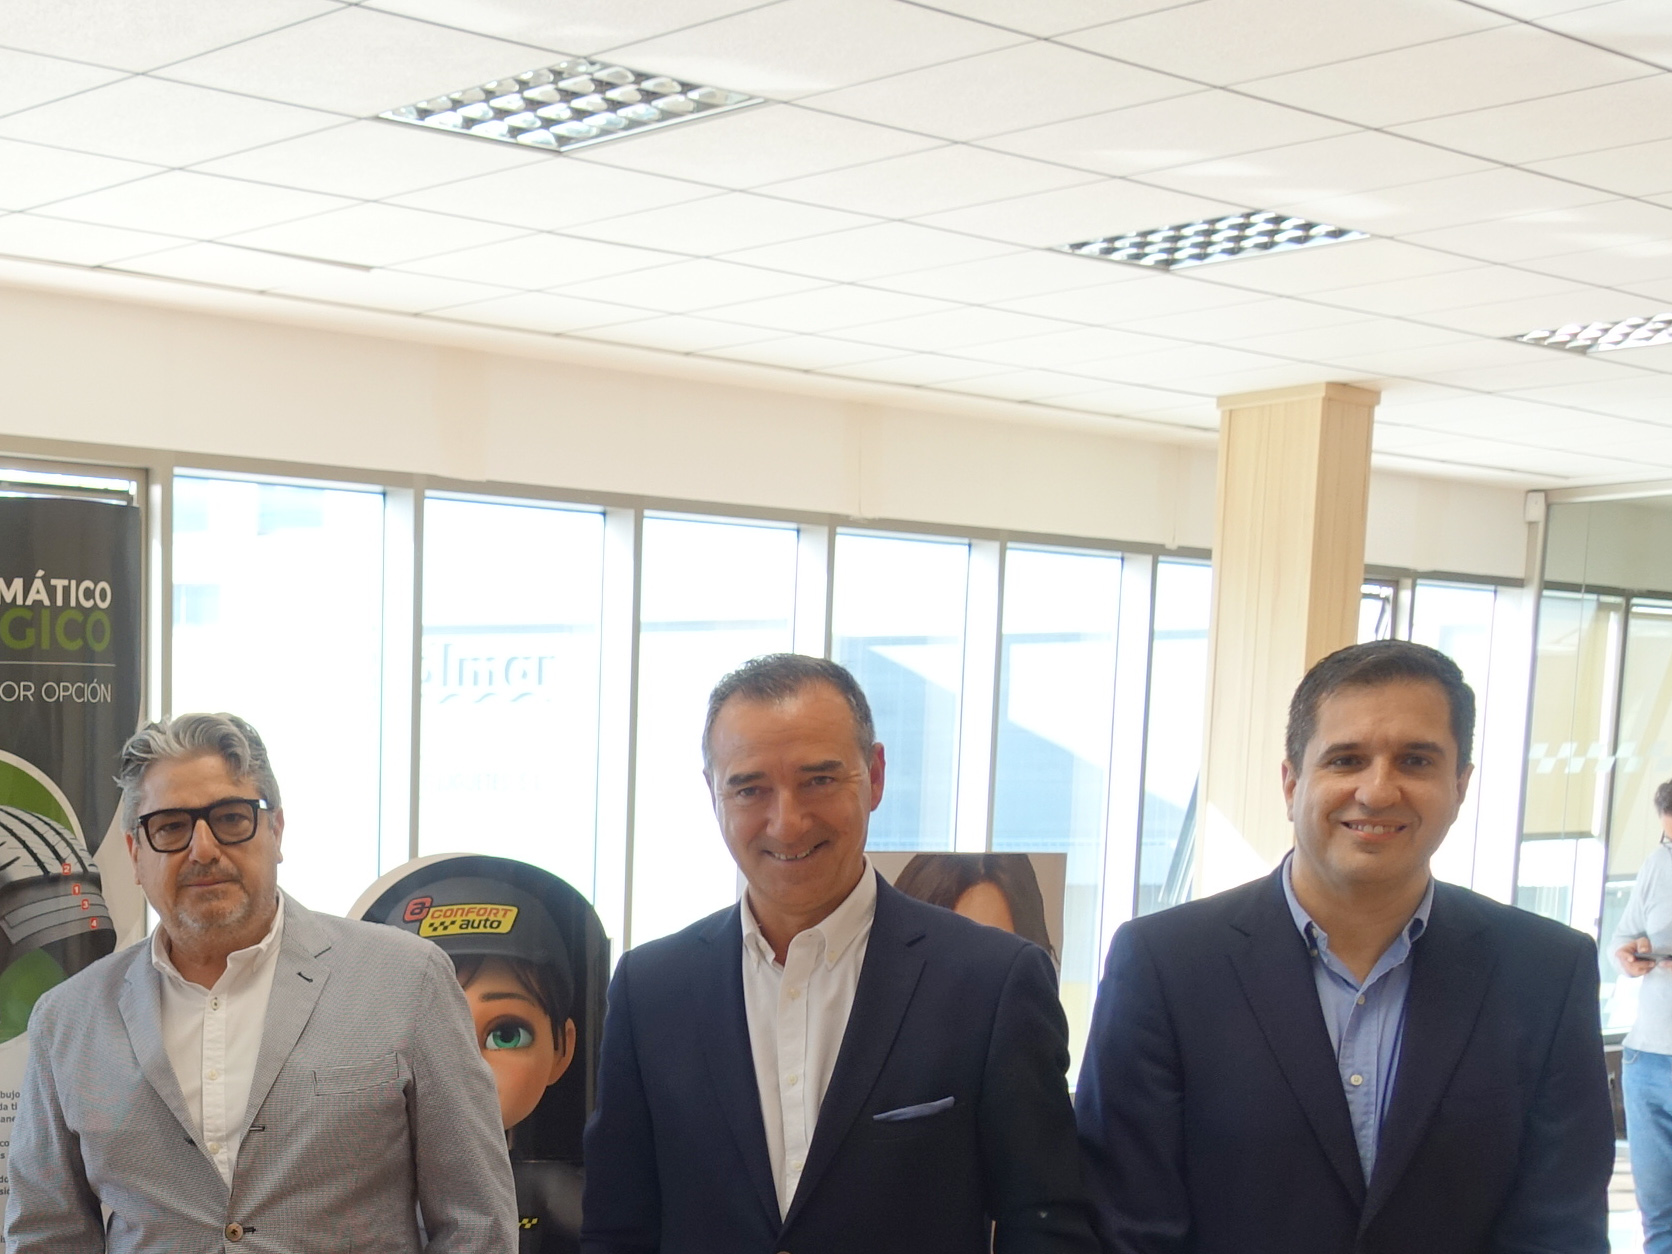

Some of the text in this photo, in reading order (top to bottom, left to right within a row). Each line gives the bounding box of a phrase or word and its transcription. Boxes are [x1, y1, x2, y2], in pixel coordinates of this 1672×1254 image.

[41, 678, 112, 703] OPCIÓN
[430, 907, 513, 920] CONFORT
[459, 918, 502, 930] auto
